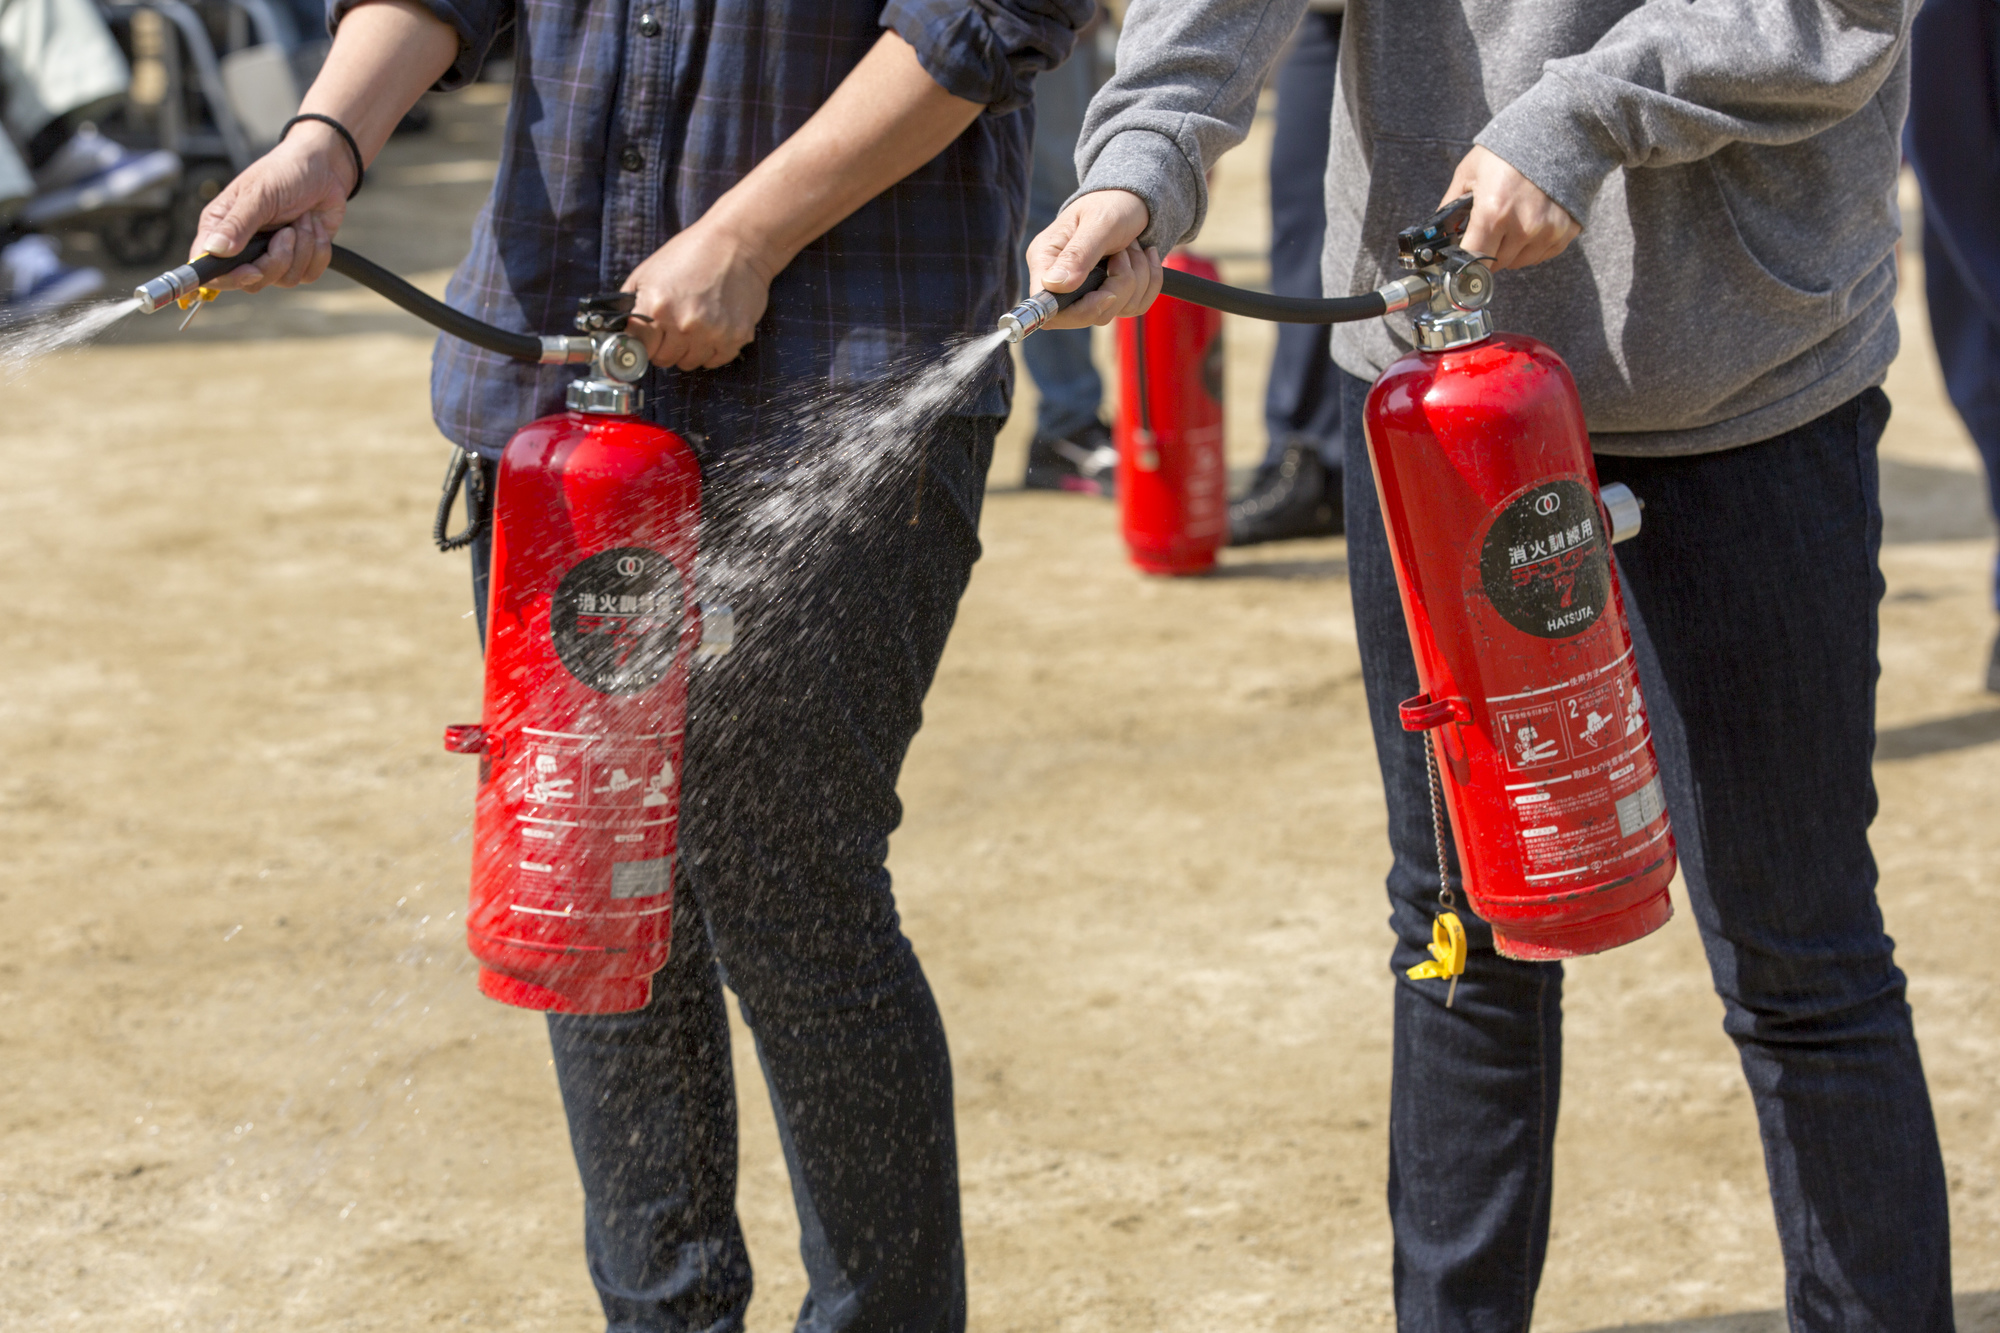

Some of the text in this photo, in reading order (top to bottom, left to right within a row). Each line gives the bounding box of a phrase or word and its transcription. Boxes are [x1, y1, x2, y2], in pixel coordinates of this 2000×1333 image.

[1508, 518, 1593, 565] 消火訓練用
[1547, 605, 1594, 632] HATSUTA
[1569, 668, 1600, 687] 使用方法
[1616, 678, 1625, 698] 3
[1568, 699, 1579, 719] 2
[1501, 714, 1510, 733] 1
